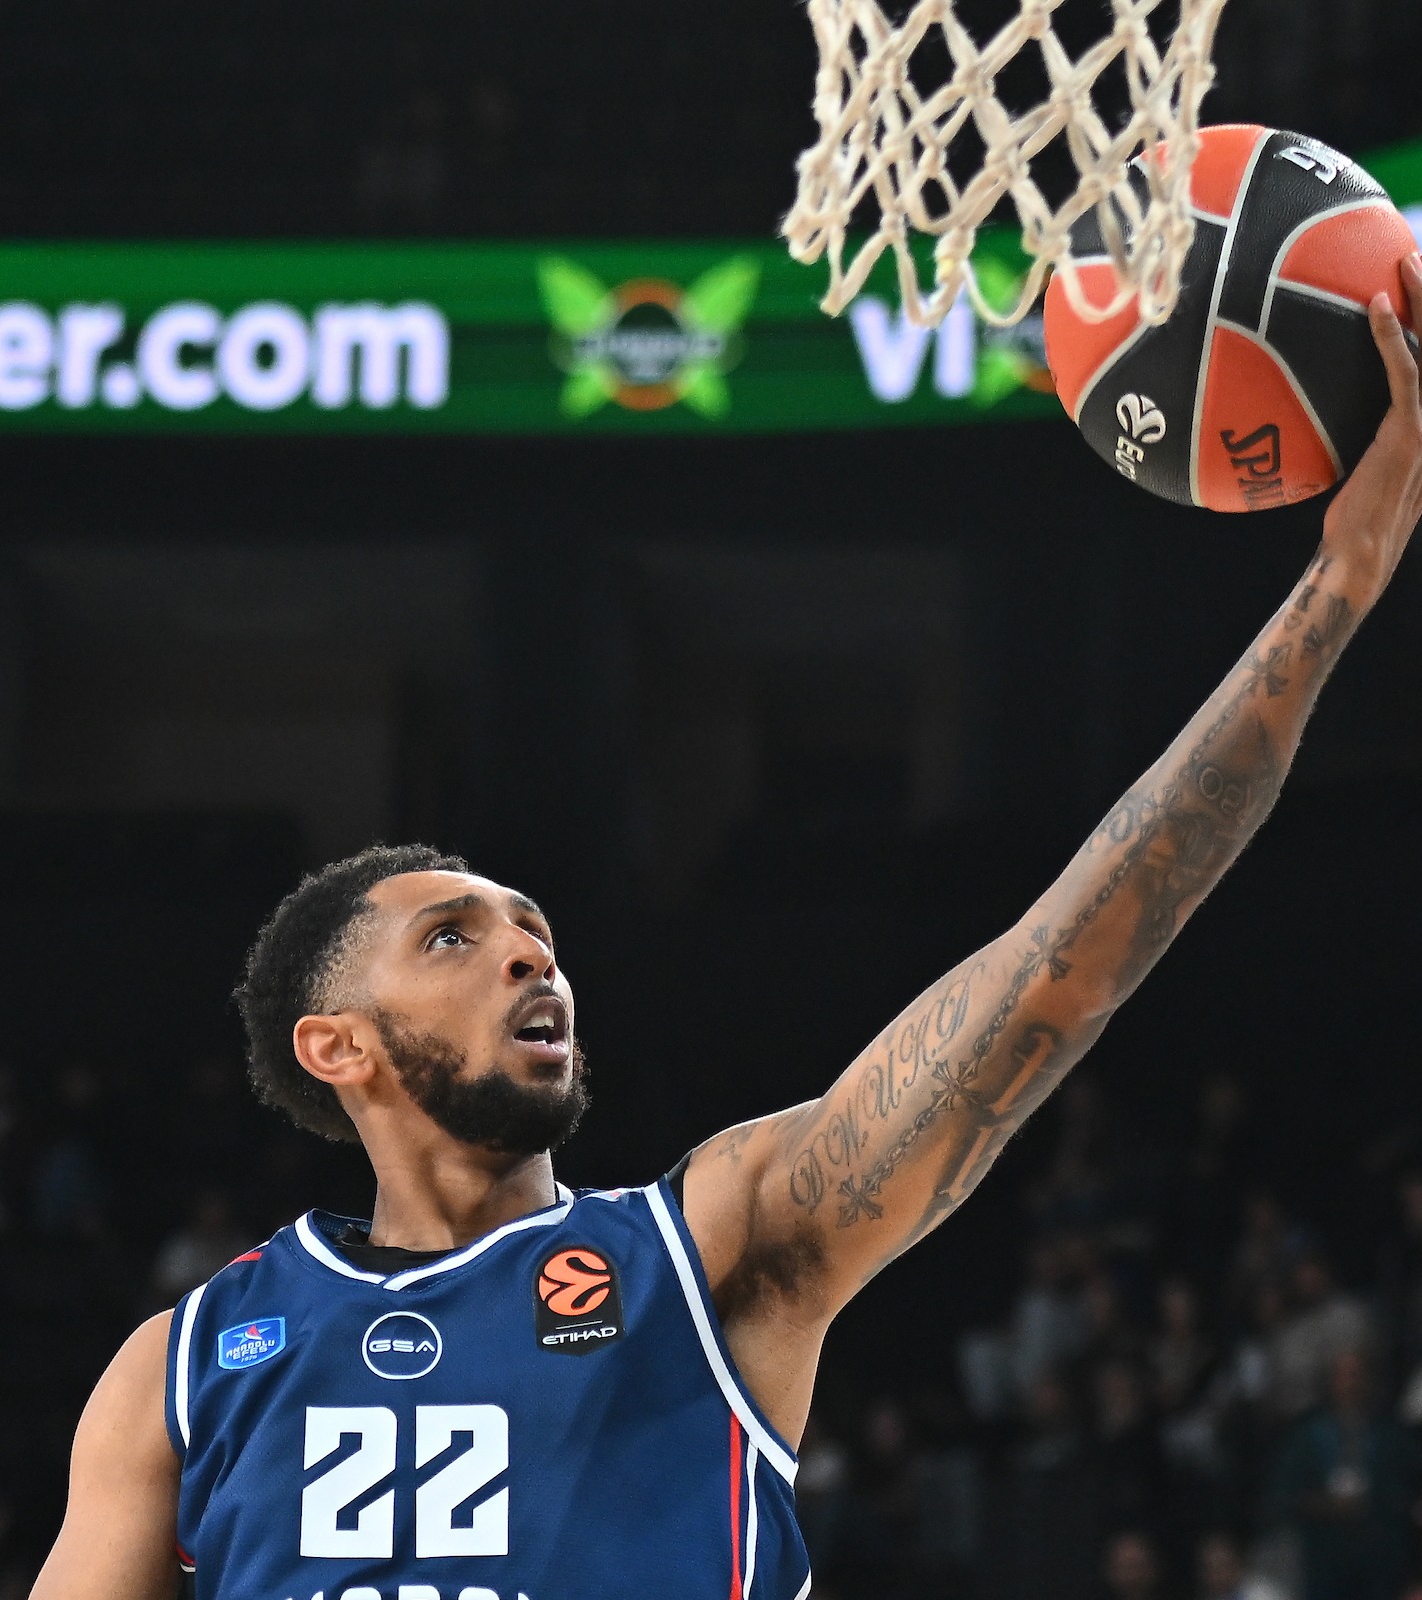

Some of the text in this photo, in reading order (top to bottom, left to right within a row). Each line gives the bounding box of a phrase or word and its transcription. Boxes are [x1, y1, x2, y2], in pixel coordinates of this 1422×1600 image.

[542, 1327, 618, 1346] ETIHAD
[369, 1340, 435, 1353] GSA
[299, 1404, 509, 1559] 22
